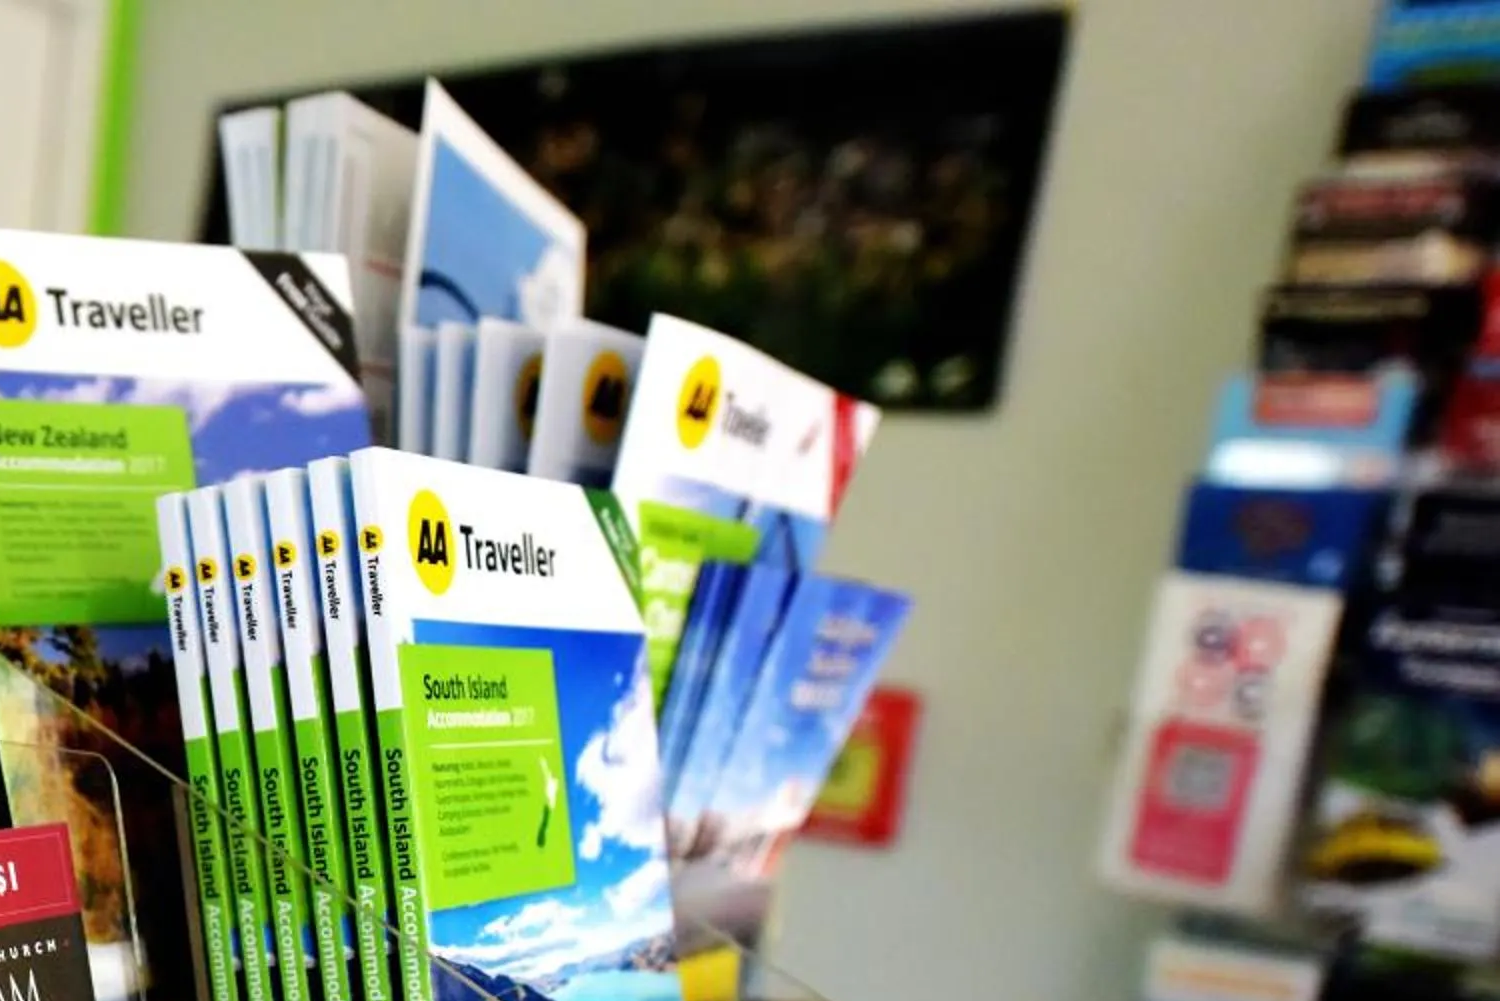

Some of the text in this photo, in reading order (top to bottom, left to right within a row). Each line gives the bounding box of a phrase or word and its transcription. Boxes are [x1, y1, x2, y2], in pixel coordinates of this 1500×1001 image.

[46, 287, 205, 335] Traveller
[40, 425, 128, 449] Zealand
[321, 535, 340, 620] AA Traveller
[364, 530, 382, 616] AA Traveller
[417, 518, 449, 566] AA
[459, 525, 556, 578] Traveller
[169, 572, 186, 651] AA Traveller
[201, 563, 219, 643] AA Traveller
[239, 559, 258, 640] AA Traveller
[279, 547, 296, 629] AA Traveller
[423, 674, 508, 700] South Island
[194, 775, 212, 833] South
[225, 768, 244, 827] South
[263, 767, 284, 828] South
[344, 749, 363, 811] South
[385, 749, 408, 812] South
[301, 757, 322, 820] South
[312, 822, 334, 887] Island
[352, 815, 375, 880] Island
[395, 816, 417, 881] Island
[199, 837, 220, 898] Island
[232, 831, 253, 895] Island
[268, 833, 290, 895] Island
